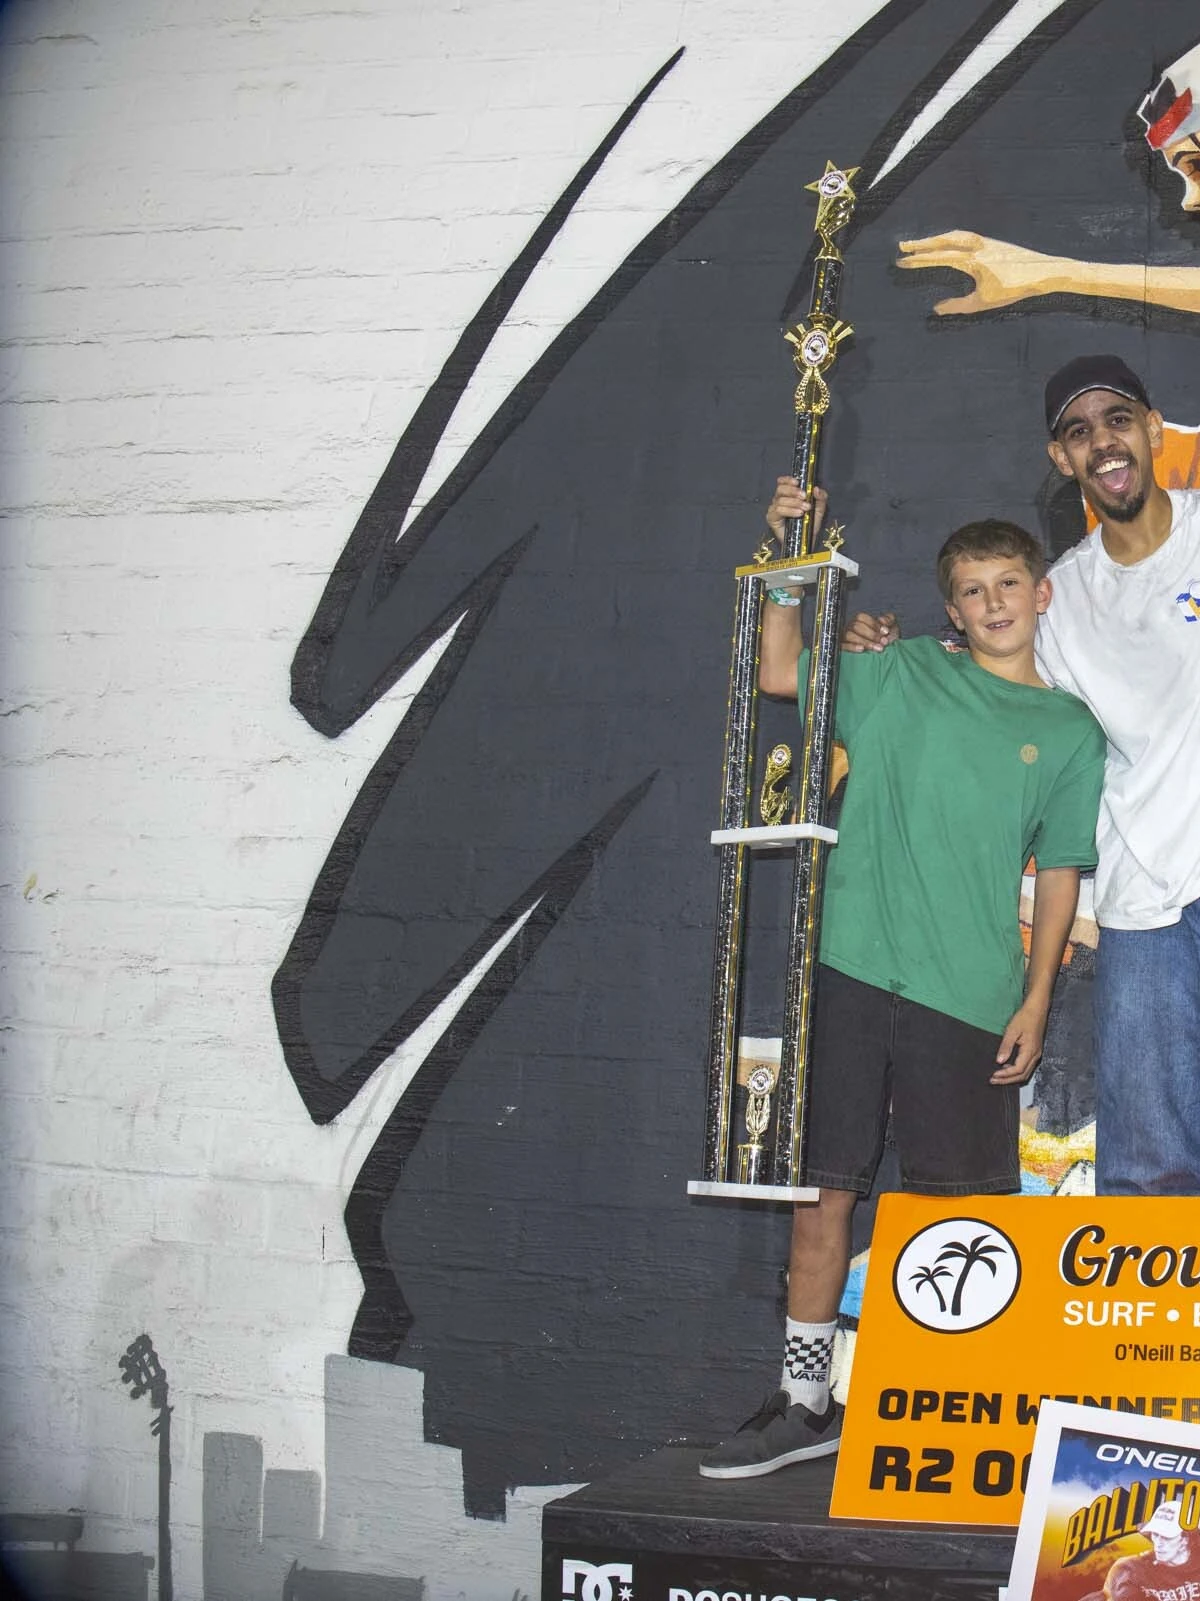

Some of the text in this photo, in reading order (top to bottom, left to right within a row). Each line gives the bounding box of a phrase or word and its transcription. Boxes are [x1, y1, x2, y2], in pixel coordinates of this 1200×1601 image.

[1063, 1300, 1156, 1327] SURF
[1114, 1343, 1174, 1362] O'Neill
[789, 1369, 827, 1382] VANS
[877, 1388, 1002, 1425] OPEN
[869, 1446, 1030, 1497] R2 0
